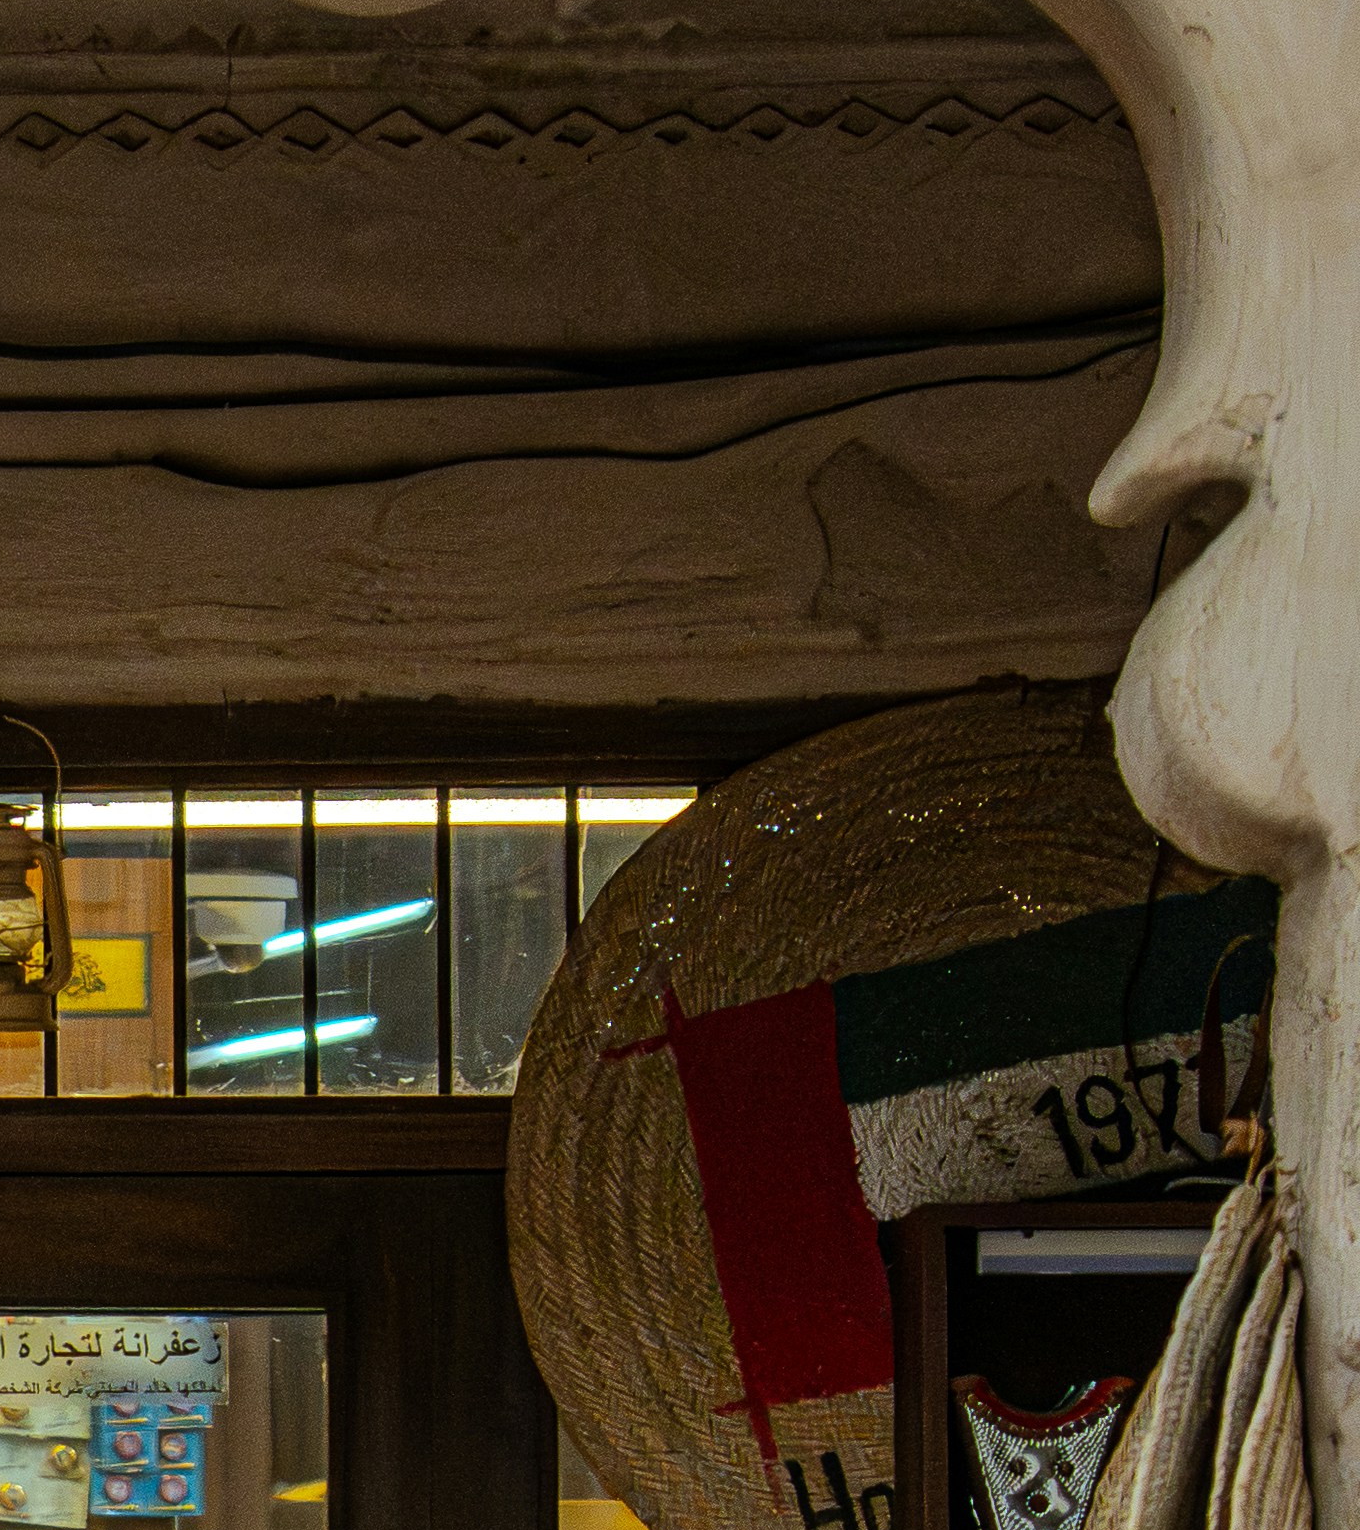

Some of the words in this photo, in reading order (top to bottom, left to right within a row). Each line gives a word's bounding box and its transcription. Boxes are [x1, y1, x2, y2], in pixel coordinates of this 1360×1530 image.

[1031, 1054, 1202, 1179] 197
[18, 1332, 102, 1366] لتجارة
[112, 1327, 221, 1365] زعفرانة
